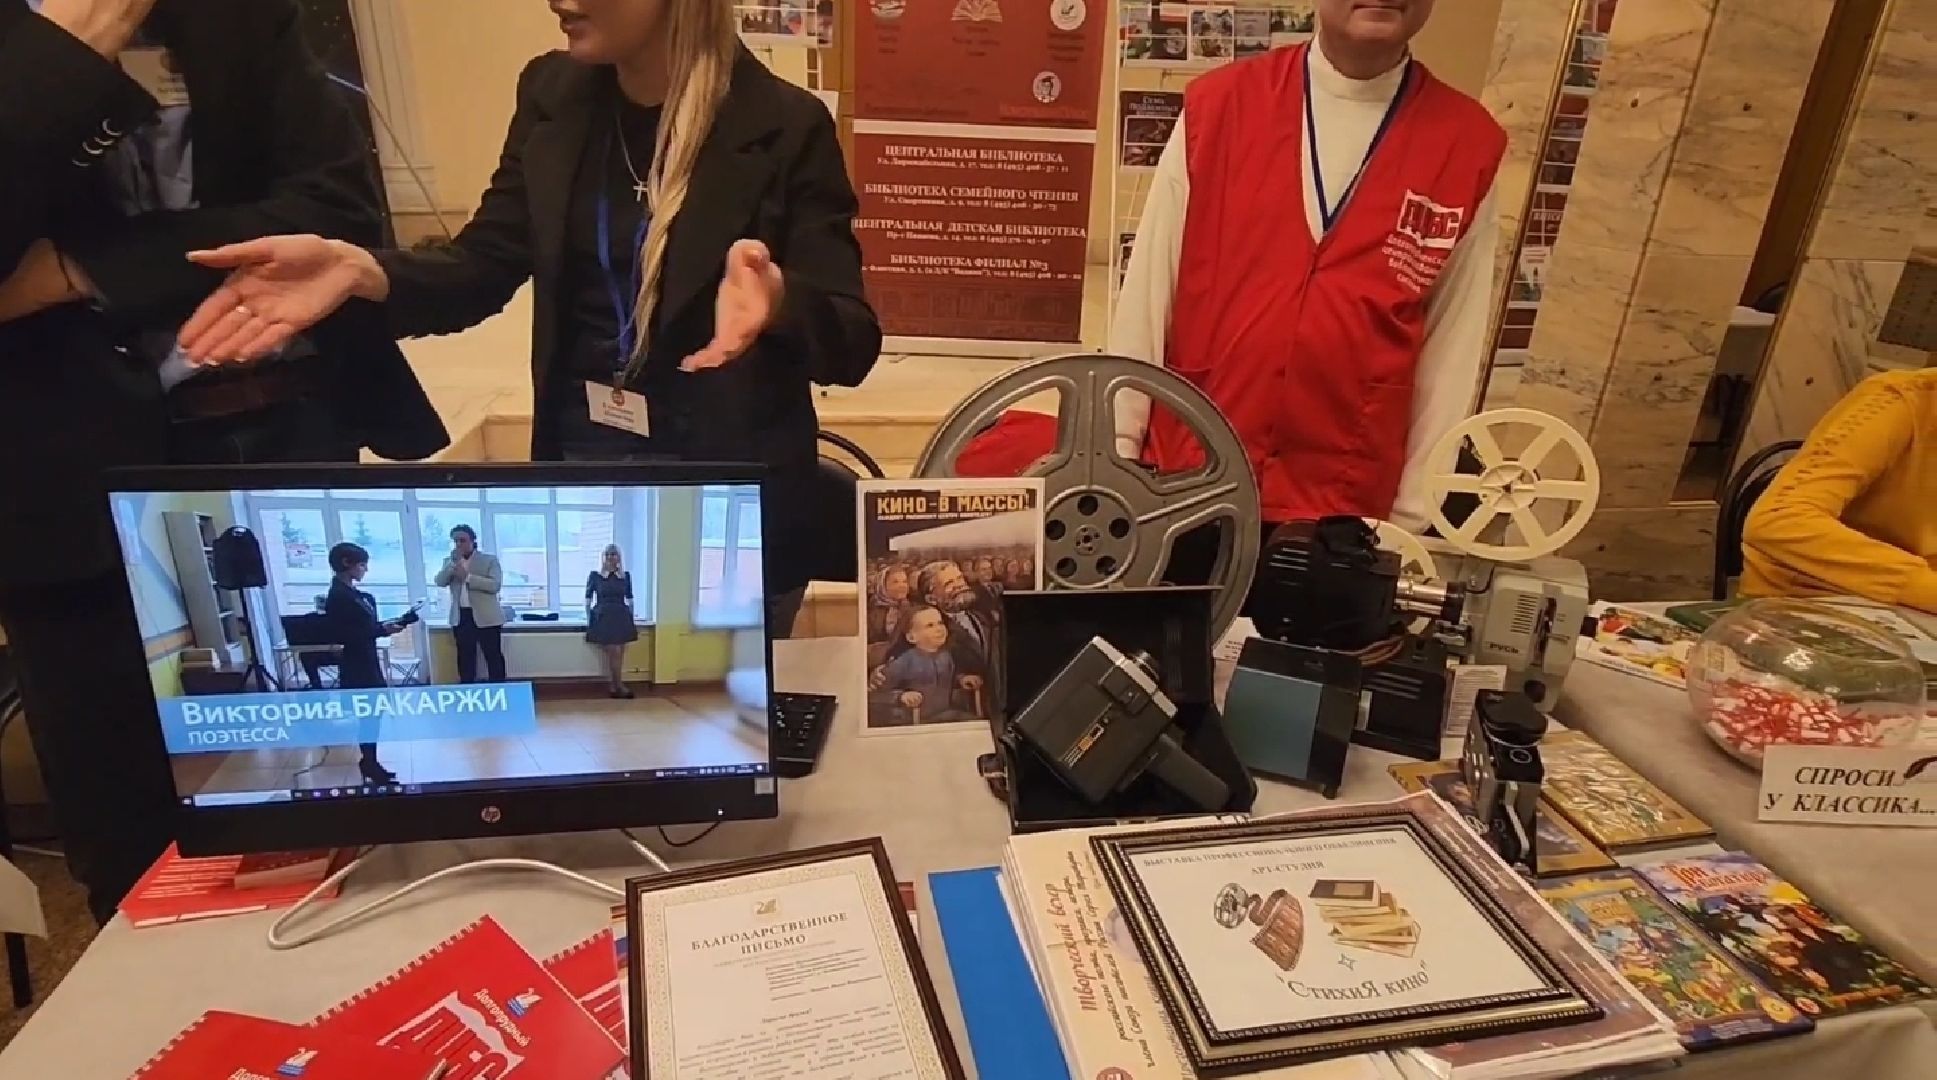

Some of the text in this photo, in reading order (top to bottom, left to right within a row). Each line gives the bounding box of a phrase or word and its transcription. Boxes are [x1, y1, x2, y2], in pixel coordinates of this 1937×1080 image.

[885, 145, 1063, 163] ЦЕНТРАЛЬНАЯ БИБЛИОТЕКА
[864, 183, 1079, 202] БИБЛИОТЕКА СЕМЕЙНОГО ЧТЕНИЯ
[948, 222, 1002, 235] ДЕТСКАЯ
[1005, 224, 1086, 238] БИБЛИОТЕКА
[890, 254, 1049, 272] БИБЛИОТЕКА ФИЛИАЛ №3
[182, 687, 508, 727] Виктория БАКАРЖИ
[187, 726, 291, 746] ПОЭТЕССА
[1763, 793, 1784, 810] У
[1251, 860, 1324, 876] АРТ-СТУДИЯ
[691, 911, 849, 951] БЛАГОДАРСТВЕННОЕ
[741, 934, 806, 955] ПИСЬМО
[474, 988, 530, 1047] Долгопрудный
